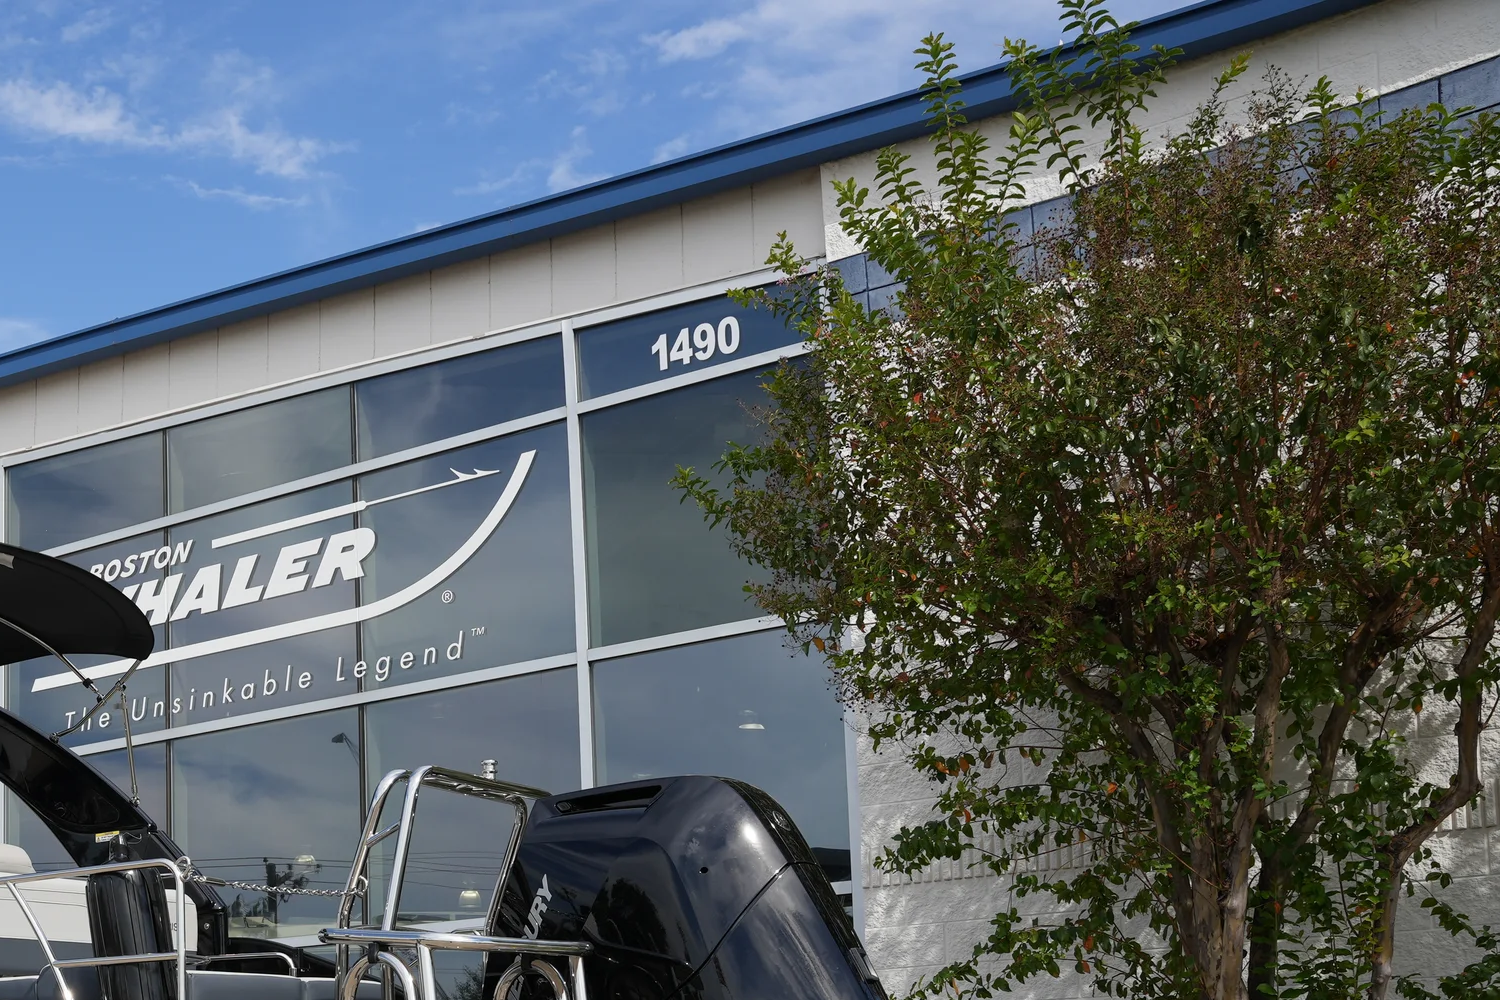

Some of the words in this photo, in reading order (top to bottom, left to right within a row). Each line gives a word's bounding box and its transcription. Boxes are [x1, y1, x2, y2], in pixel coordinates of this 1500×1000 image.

[651, 316, 740, 371] 1490
[90, 539, 193, 582] BOSTON
[121, 527, 376, 626] HALER
[65, 706, 111, 732] The
[131, 664, 313, 721] Unsinkable
